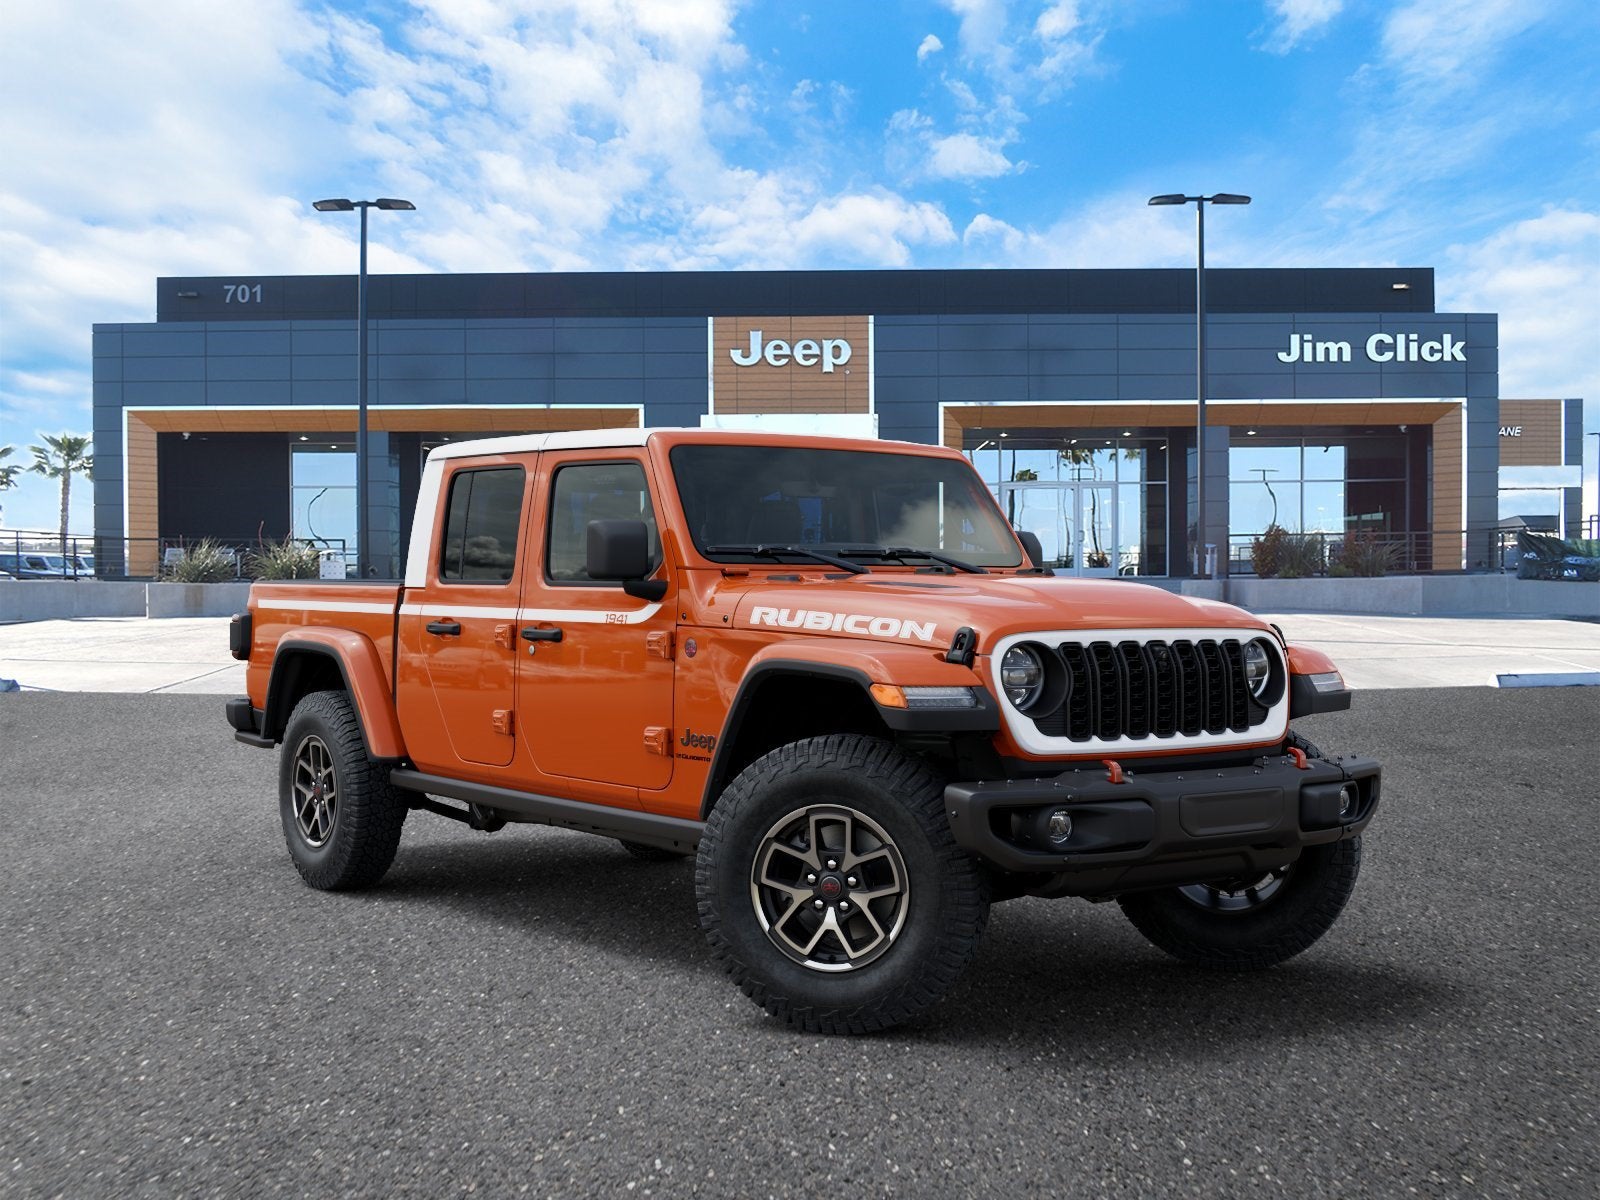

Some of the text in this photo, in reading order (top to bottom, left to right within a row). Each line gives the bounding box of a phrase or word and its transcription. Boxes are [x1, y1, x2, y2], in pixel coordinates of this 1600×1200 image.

[223, 284, 261, 303] 701
[729, 330, 852, 373] Jeep
[1277, 333, 1467, 362] Jim Click
[605, 613, 628, 624] 1941
[749, 606, 937, 642] RUBICON
[680, 727, 716, 753] Jeep
